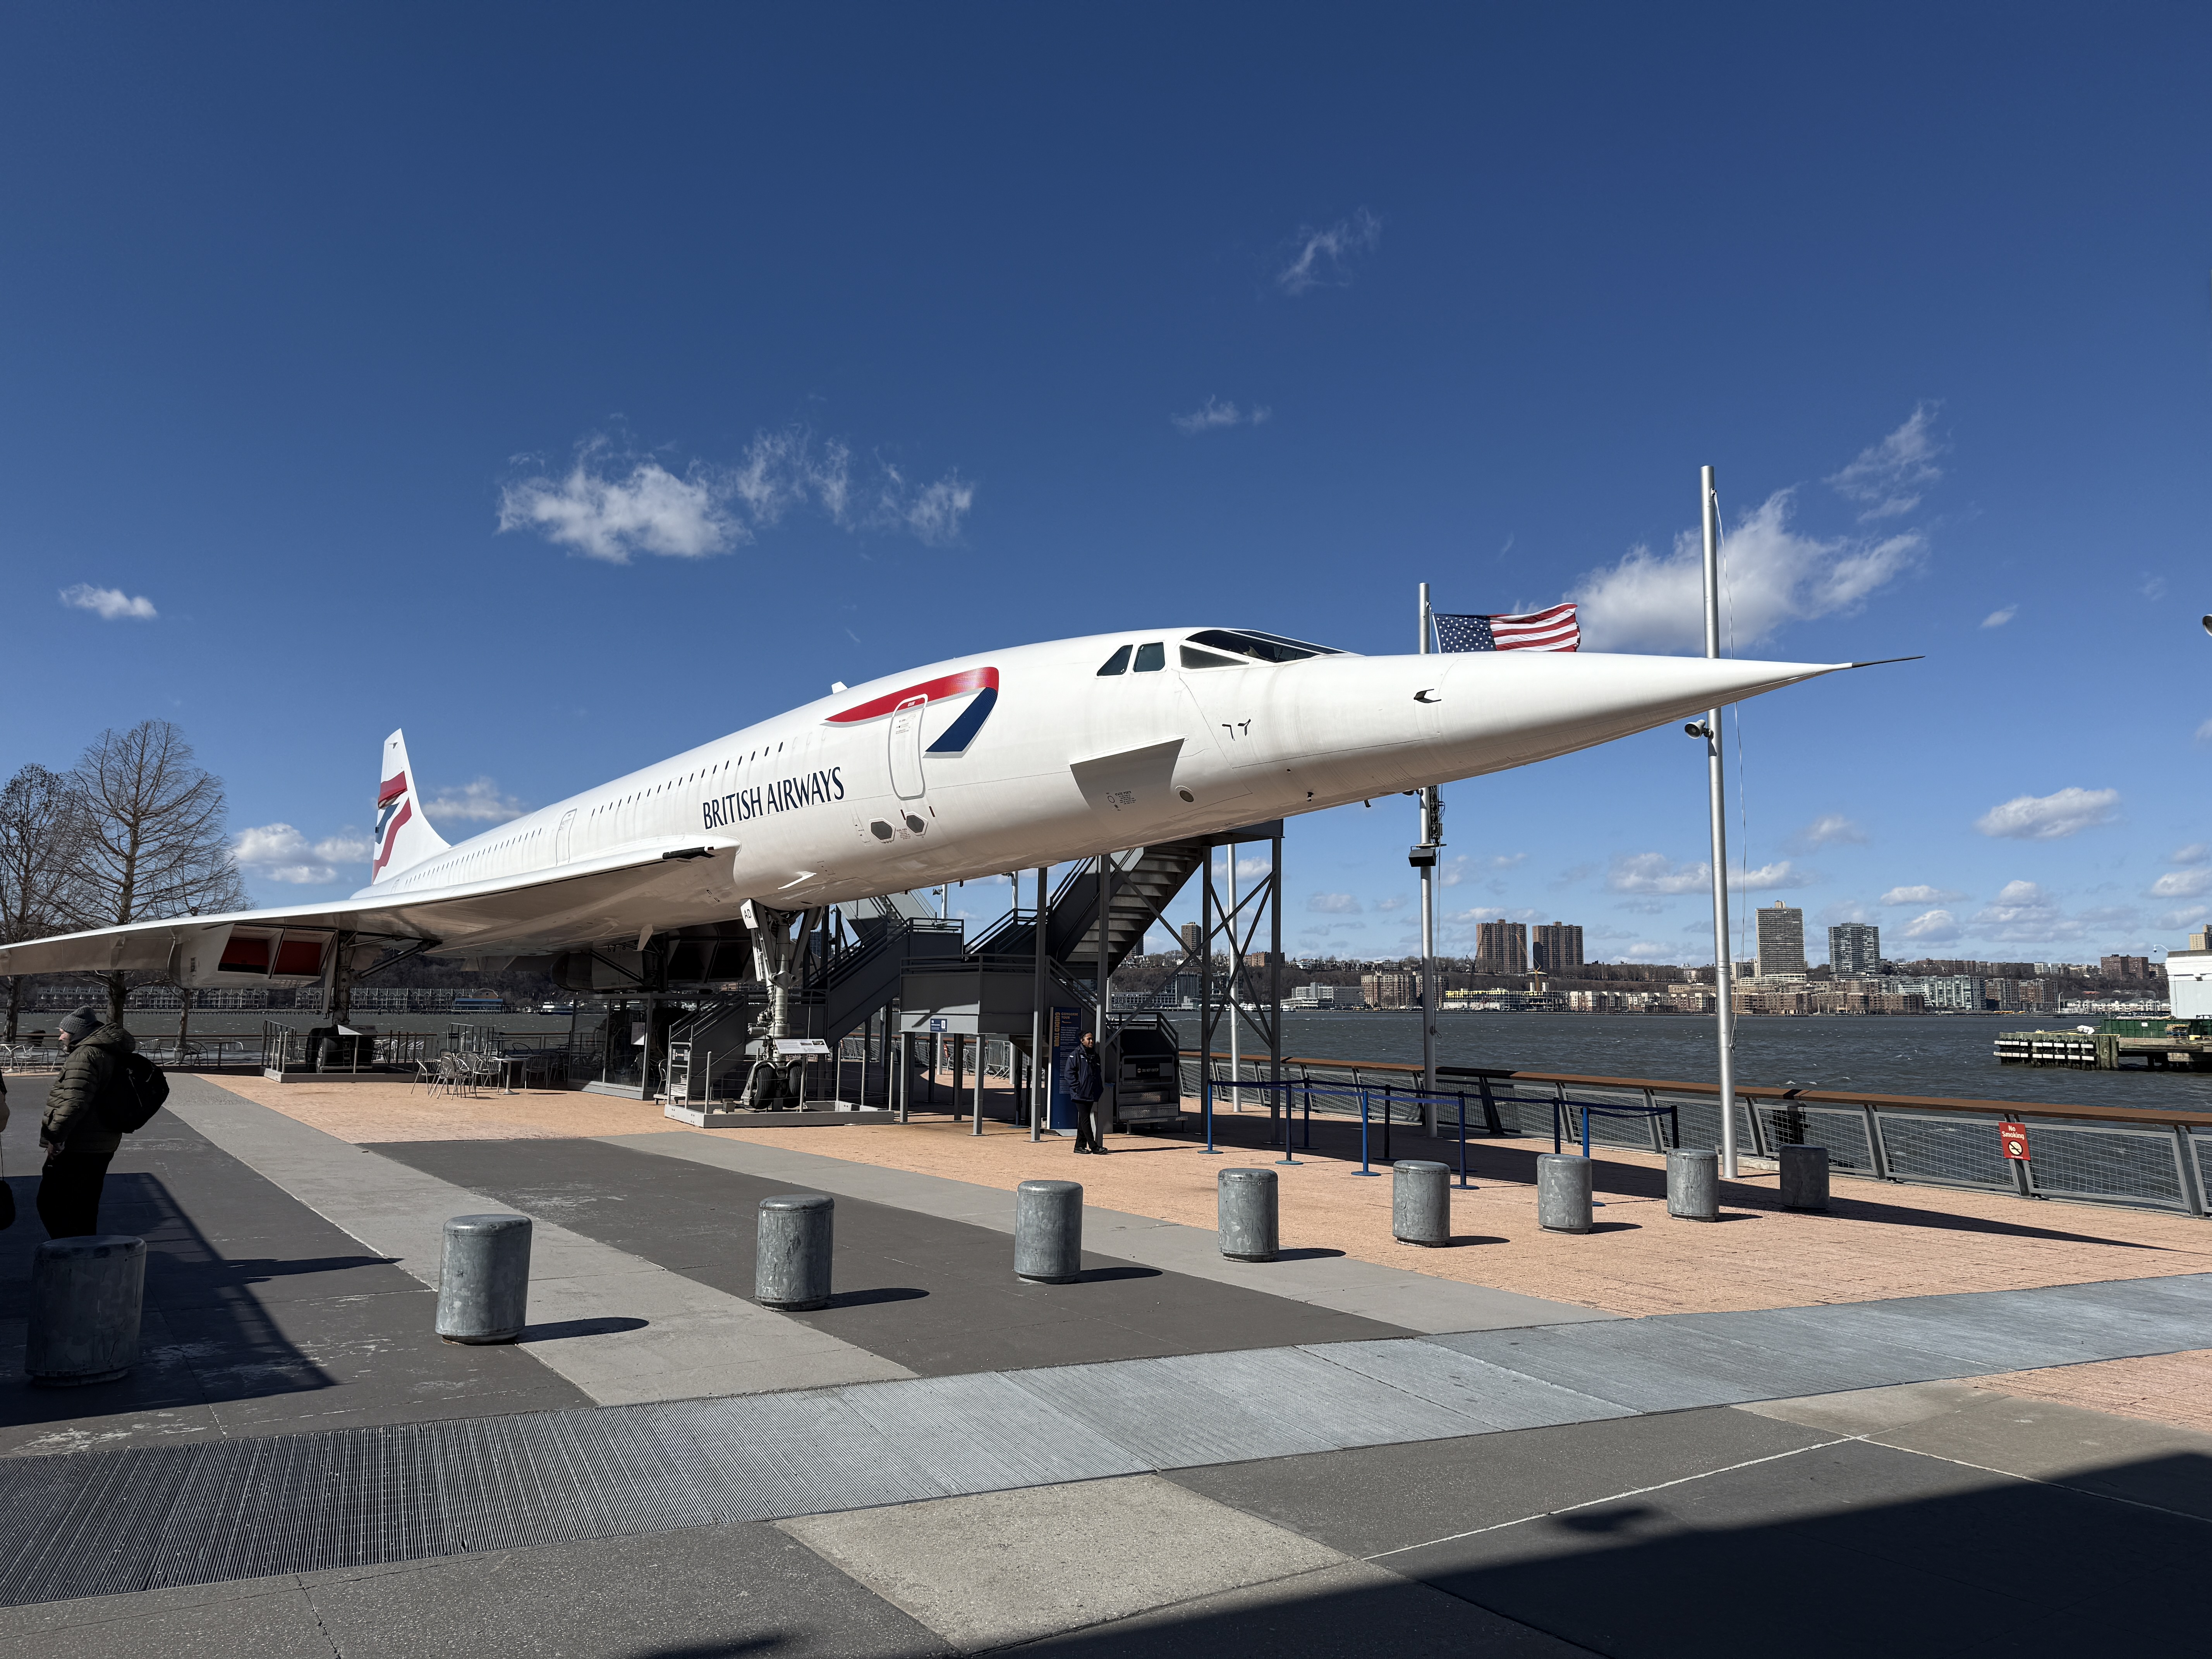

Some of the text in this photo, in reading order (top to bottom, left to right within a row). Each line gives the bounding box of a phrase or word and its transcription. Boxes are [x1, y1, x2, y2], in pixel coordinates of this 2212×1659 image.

[703, 766, 845, 830] BRITISH AIRWAYS
[744, 909, 751, 919] AD
[2002, 1131, 2025, 1140] Smoking
